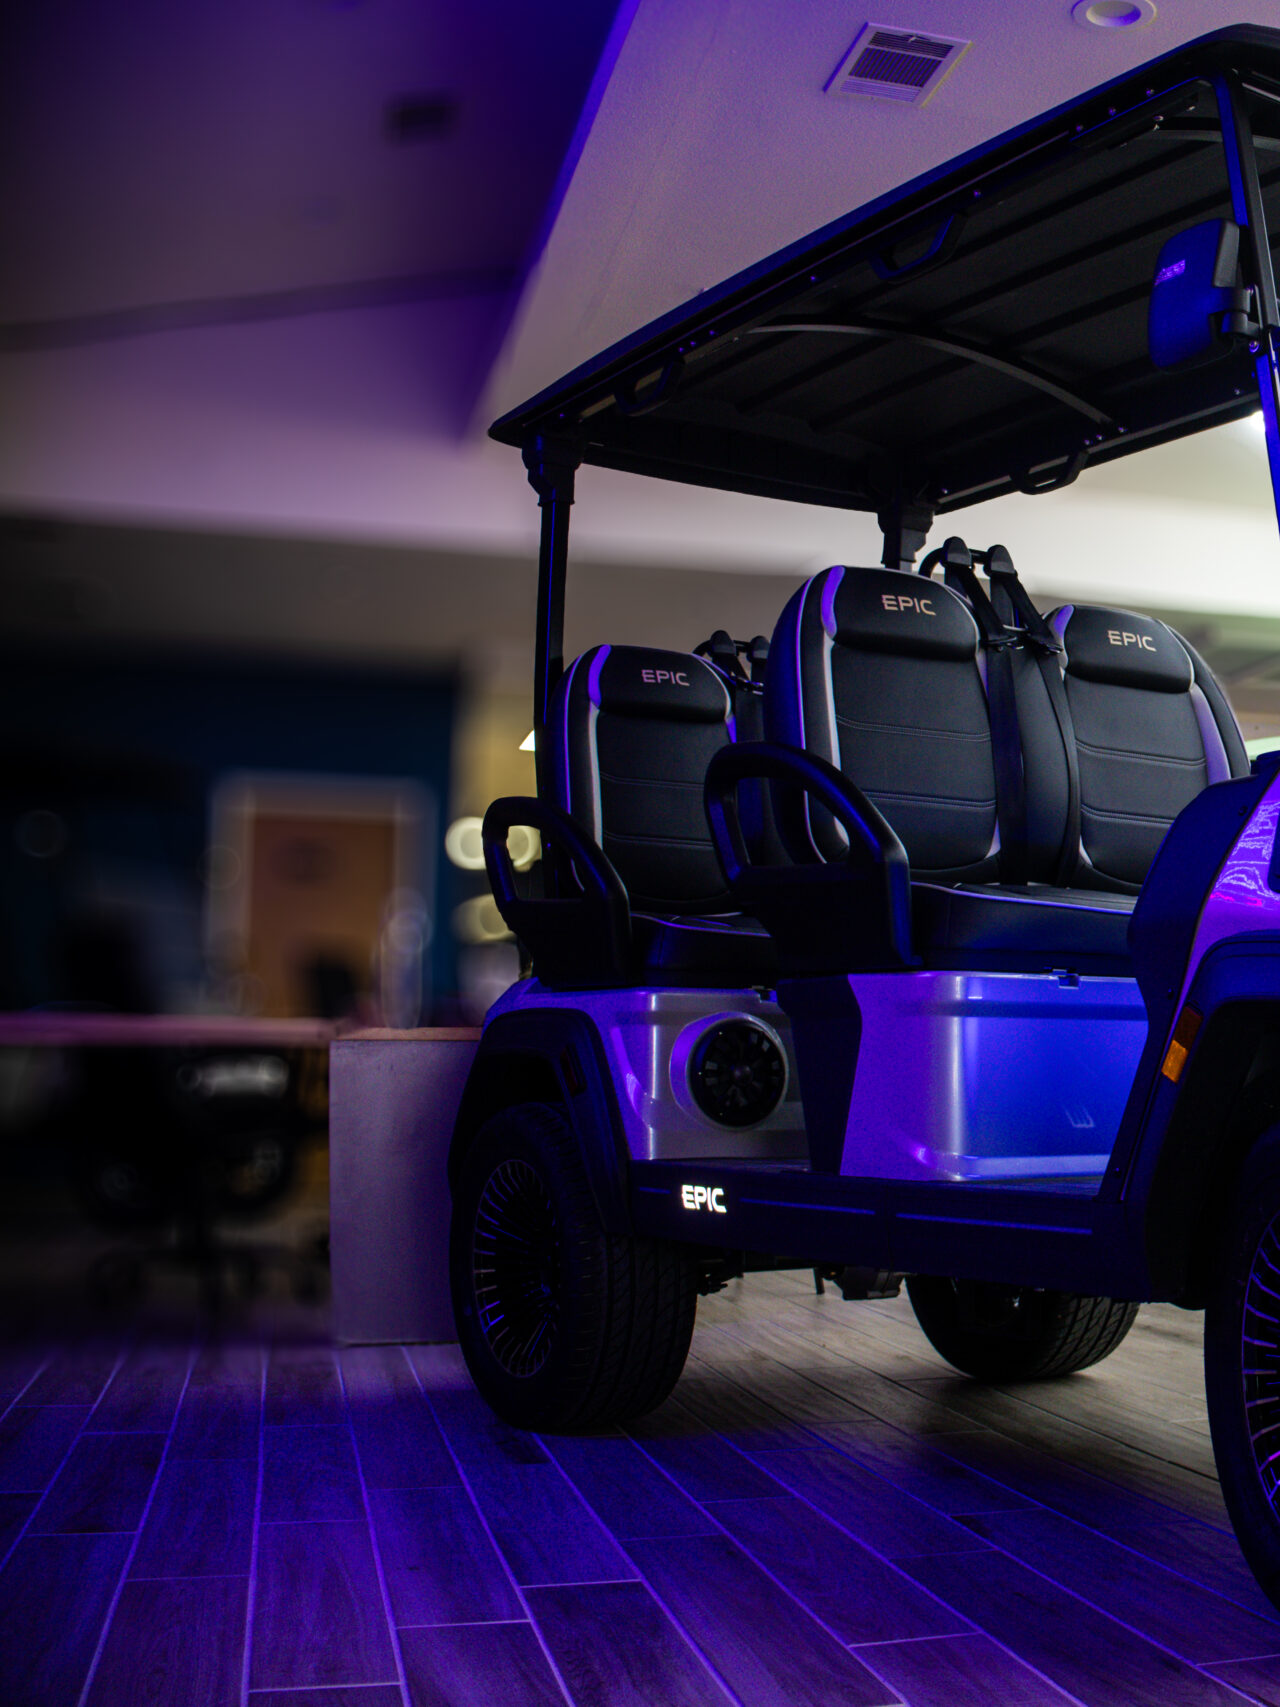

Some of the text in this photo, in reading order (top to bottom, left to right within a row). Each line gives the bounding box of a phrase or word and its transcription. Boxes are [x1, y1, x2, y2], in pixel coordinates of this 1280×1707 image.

[881, 594, 936, 616] EPIC
[1107, 630, 1157, 652] EPIC
[641, 669, 690, 687] EPIC
[681, 1184, 728, 1214] EPIC
